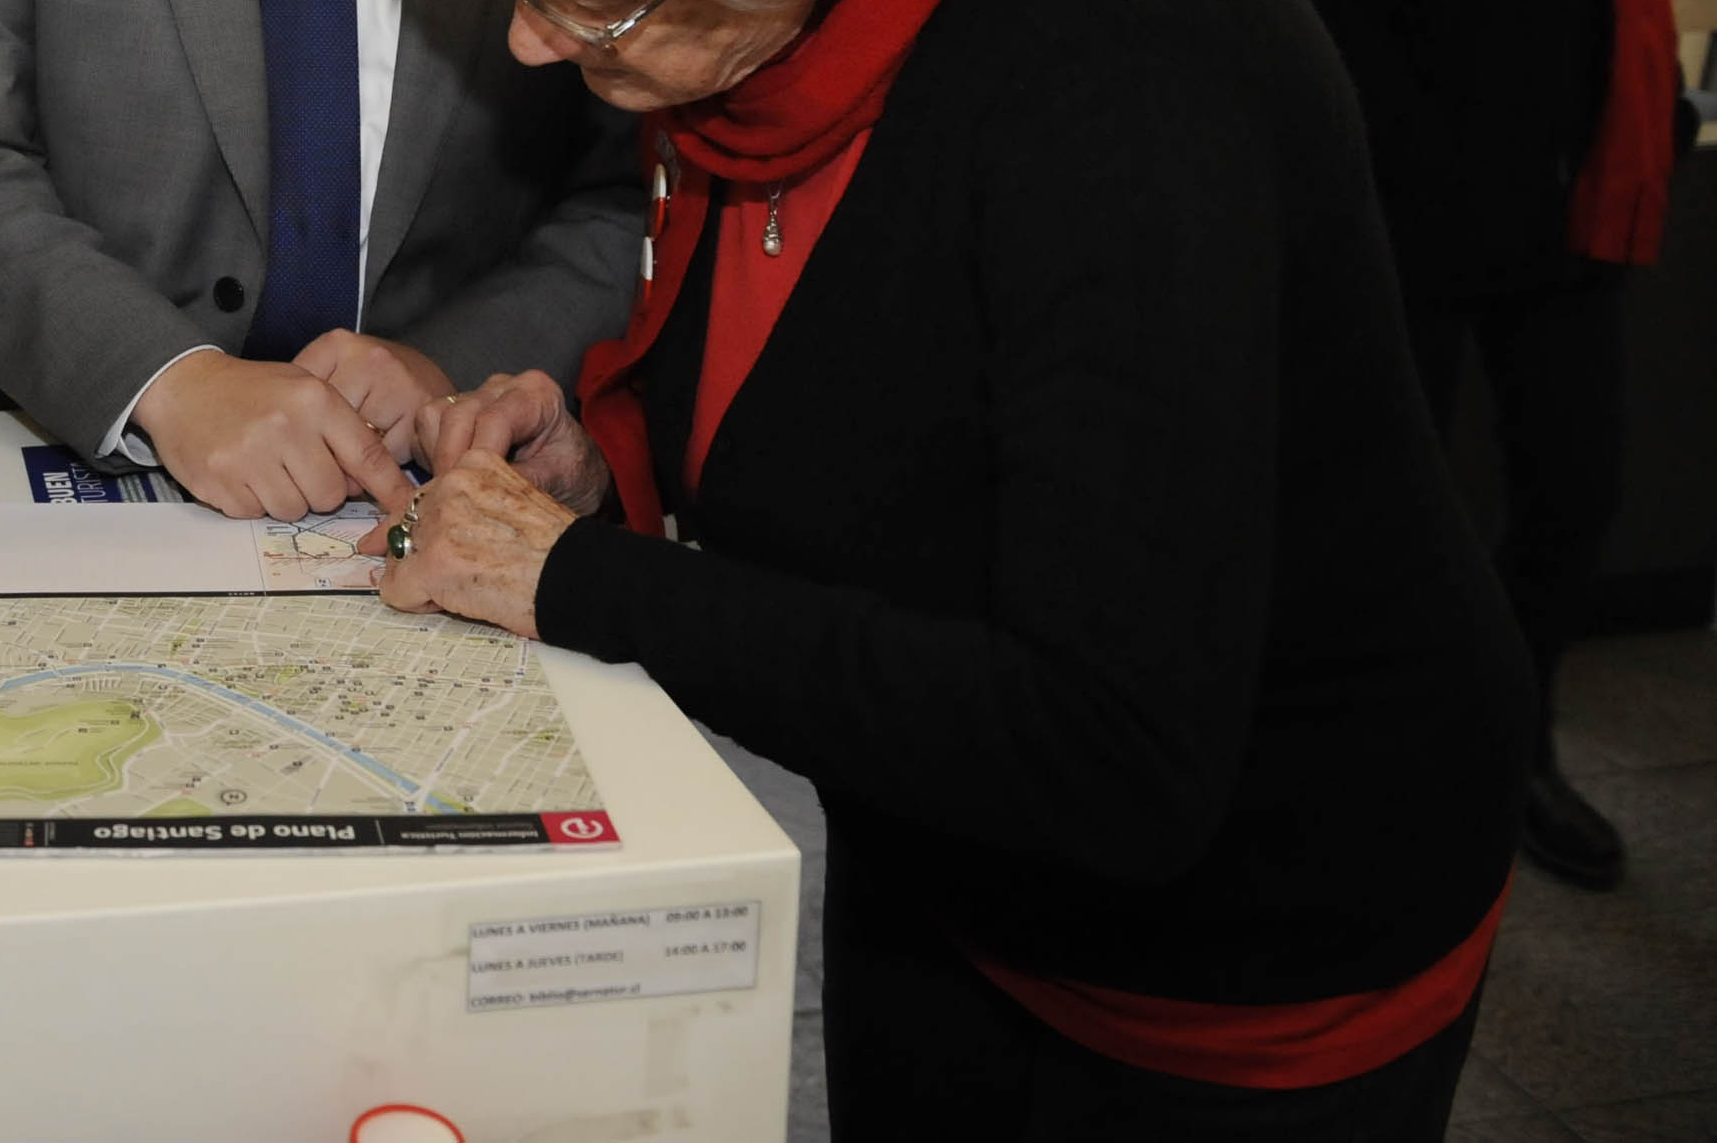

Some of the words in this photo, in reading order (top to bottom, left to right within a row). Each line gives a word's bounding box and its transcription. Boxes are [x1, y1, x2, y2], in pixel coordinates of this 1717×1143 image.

[42, 471, 78, 504] BUEN
[93, 822, 223, 842] Santiago
[229, 824, 266, 841] de
[272, 824, 356, 841] Plano
[472, 927, 513, 939] LUNES
[516, 925, 526, 934] A
[528, 920, 579, 934] VIERNES
[583, 912, 650, 932] (MAÑANA)
[703, 909, 712, 919] A
[471, 961, 513, 974] LUNES
[515, 960, 525, 969] A
[527, 955, 571, 969] JUEVES
[575, 949, 624, 965] (TARDE)
[701, 943, 710, 953] A
